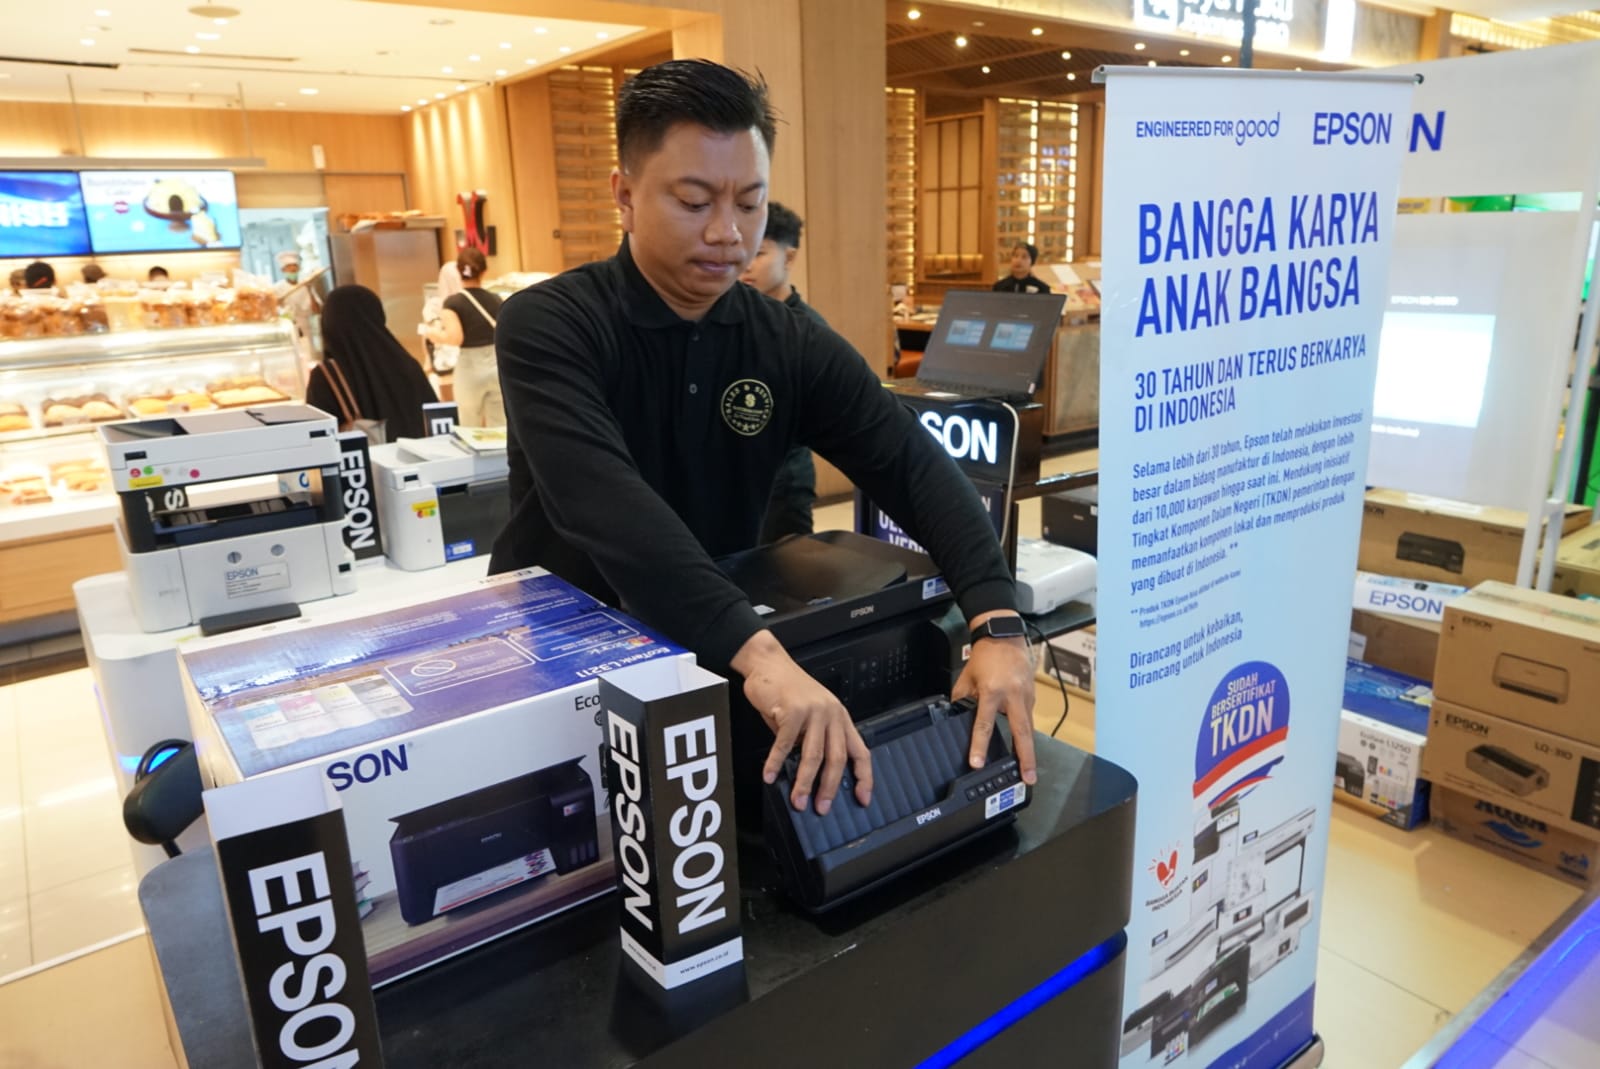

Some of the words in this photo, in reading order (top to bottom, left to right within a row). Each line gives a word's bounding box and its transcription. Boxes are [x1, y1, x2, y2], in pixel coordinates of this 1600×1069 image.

[1136, 120, 1211, 138] ENGINEERED
[1214, 120, 1233, 137] FOR
[1235, 111, 1280, 146] good
[1313, 112, 1392, 145] EPSON
[1408, 110, 1446, 152] N
[1139, 197, 1276, 264] BANGGA
[1288, 191, 1378, 250] KARYA
[1135, 268, 1232, 337] ANAK
[1239, 255, 1359, 321] BANGSA
[1135, 371, 1157, 400] 30
[1162, 360, 1214, 396] TAHUN
[1217, 354, 1243, 385] DAN
[1248, 346, 1297, 377] TERUS
[1301, 334, 1366, 369] BERKARYA
[1135, 403, 1152, 432] DI
[1159, 386, 1236, 428] INDONESIA
[1133, 461, 1170, 479] Selama
[1172, 454, 1194, 471] lebih
[1196, 448, 1210, 465] dari
[1244, 434, 1270, 450] Epson
[1272, 427, 1293, 443] telah
[1133, 484, 1160, 501] besar
[1163, 478, 1191, 495] dalam
[1262, 452, 1270, 466] di
[340, 450, 376, 549] EPSON
[1132, 507, 1153, 525] dari
[1156, 499, 1185, 521] 10,000
[1187, 489, 1220, 511] karyawan
[1247, 474, 1266, 490] saat
[1132, 527, 1169, 548] Tingkat
[1171, 514, 1210, 539] Komponen
[1211, 505, 1232, 523] Dalam
[1233, 496, 1260, 514] Negeri
[1131, 540, 1198, 571] memanfaatkan
[1199, 526, 1233, 549] komponen
[1234, 517, 1254, 534] lokal
[1255, 514, 1272, 529] dan
[1131, 577, 1155, 596] yang
[1157, 566, 1184, 585] dibuat
[1186, 562, 1194, 576] di
[1369, 589, 1442, 615] EPSON
[850, 605, 874, 619] EPSON
[1462, 616, 1493, 631] EPSON
[1129, 660, 1181, 689] Dirancang
[1182, 647, 1204, 669] untuk
[1205, 627, 1242, 657] Indonesia
[1130, 640, 1181, 669] Dirancang
[1183, 627, 1205, 650] untuk
[1211, 680, 1276, 720] BERSERTIFIKAT
[1227, 672, 1258, 696] SUDAH
[1210, 696, 1274, 757] TKDN
[1445, 713, 1489, 735] EPSON
[607, 709, 653, 932] EPSON
[663, 714, 727, 935] EPSON
[915, 807, 942, 825] EPSON
